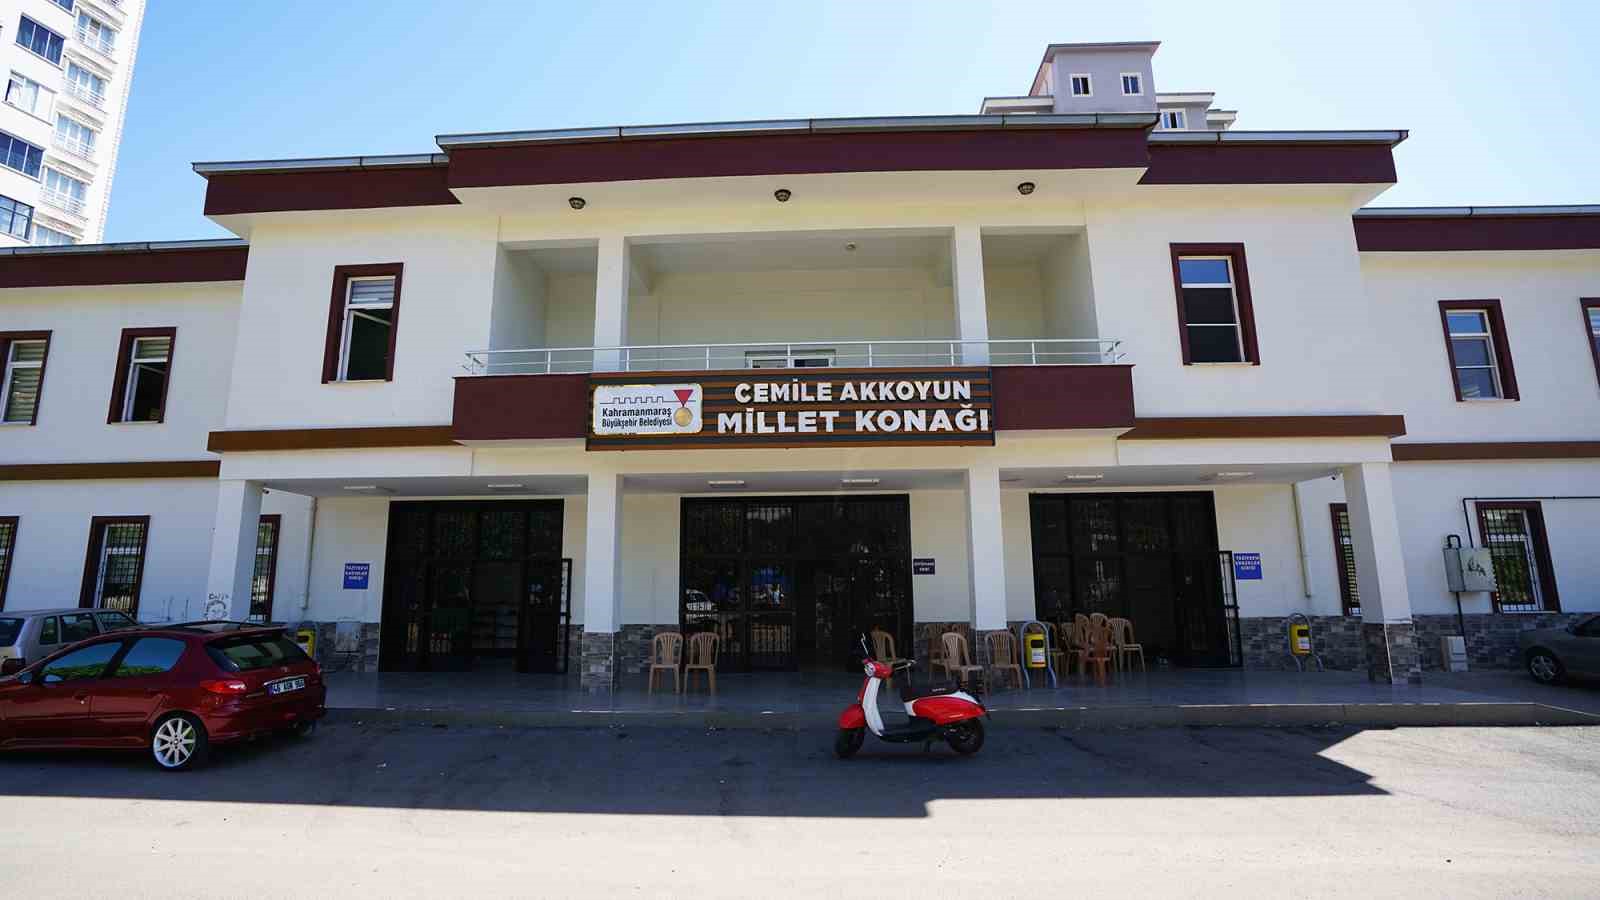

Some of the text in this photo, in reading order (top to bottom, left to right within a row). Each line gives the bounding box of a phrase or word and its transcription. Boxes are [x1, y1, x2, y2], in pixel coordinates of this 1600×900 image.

[735, 378, 972, 403] CEMİLE AKKOYUN
[602, 407, 672, 418] Kahramanmaraş
[717, 403, 989, 434] MİLLET KONAĞI
[602, 416, 673, 429] Büyükşehir Belediyesi
